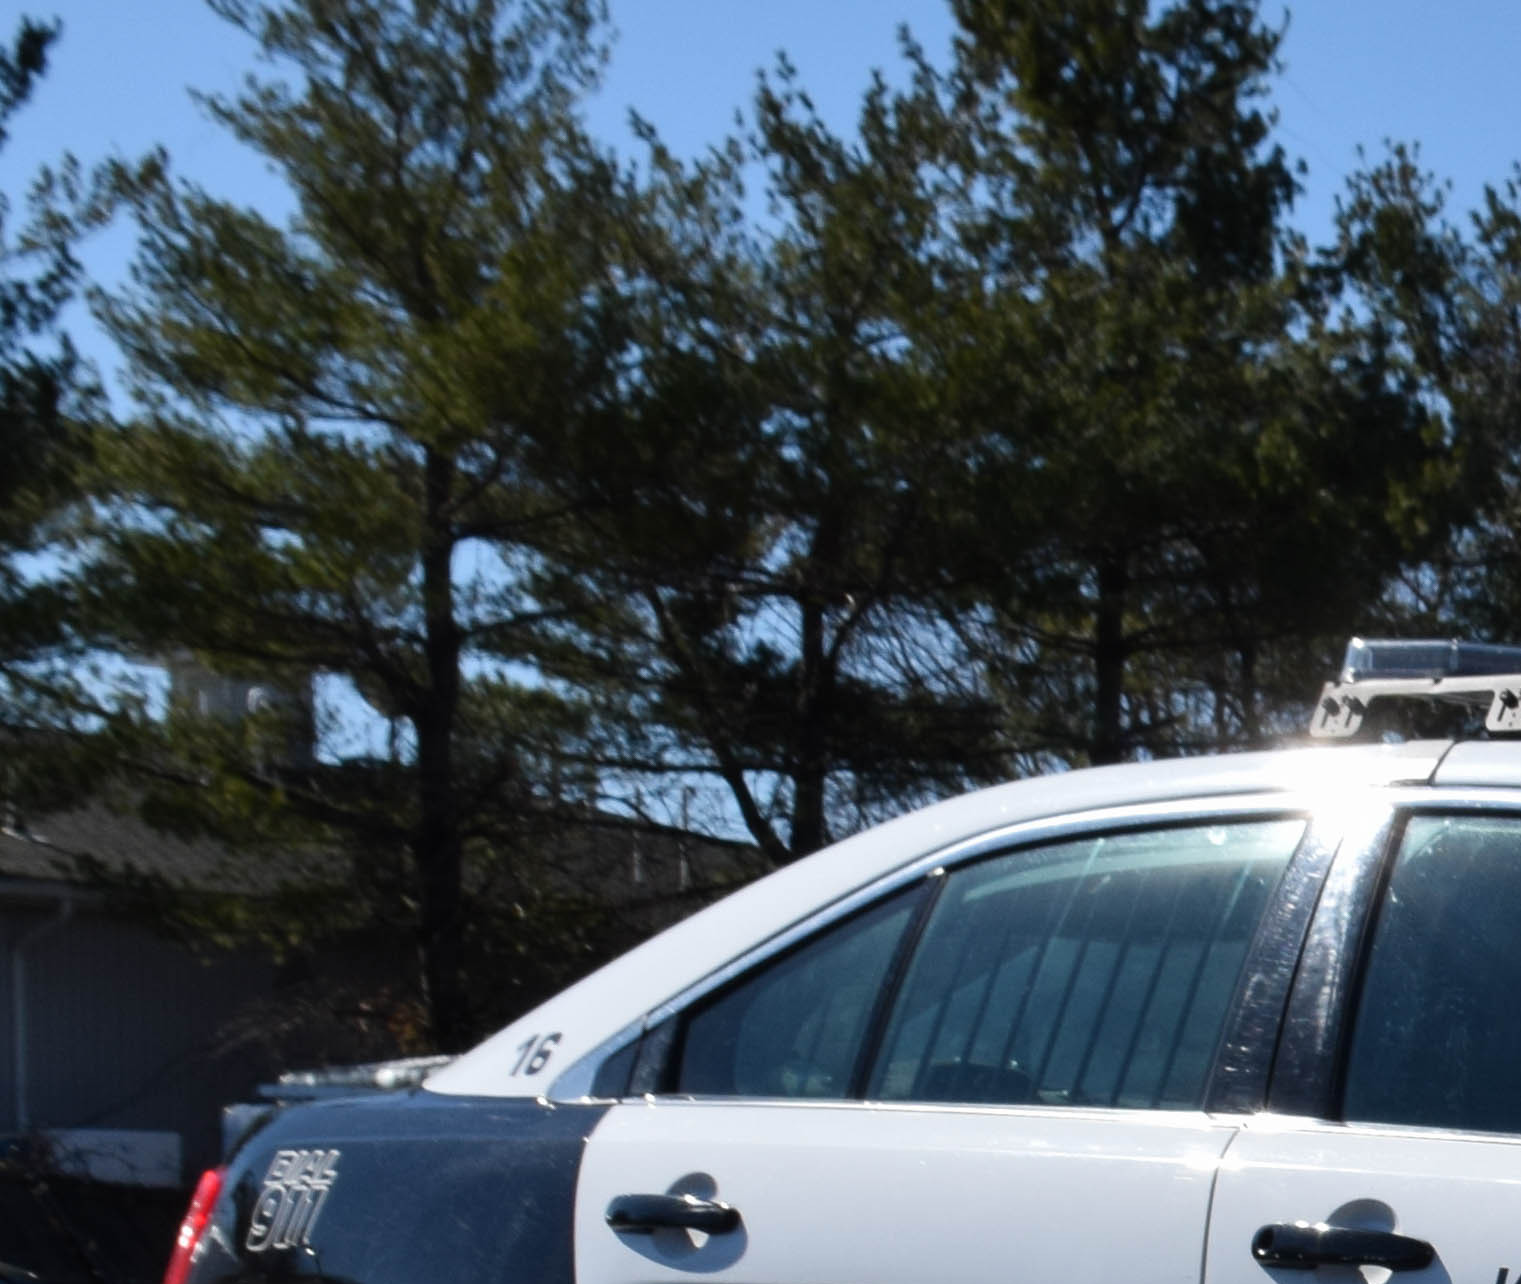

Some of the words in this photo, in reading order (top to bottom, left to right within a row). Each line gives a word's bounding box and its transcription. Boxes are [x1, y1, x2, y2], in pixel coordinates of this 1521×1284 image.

[510, 1032, 562, 1076] 16
[263, 1149, 340, 1186] DIAL
[246, 1184, 329, 1252] 911
